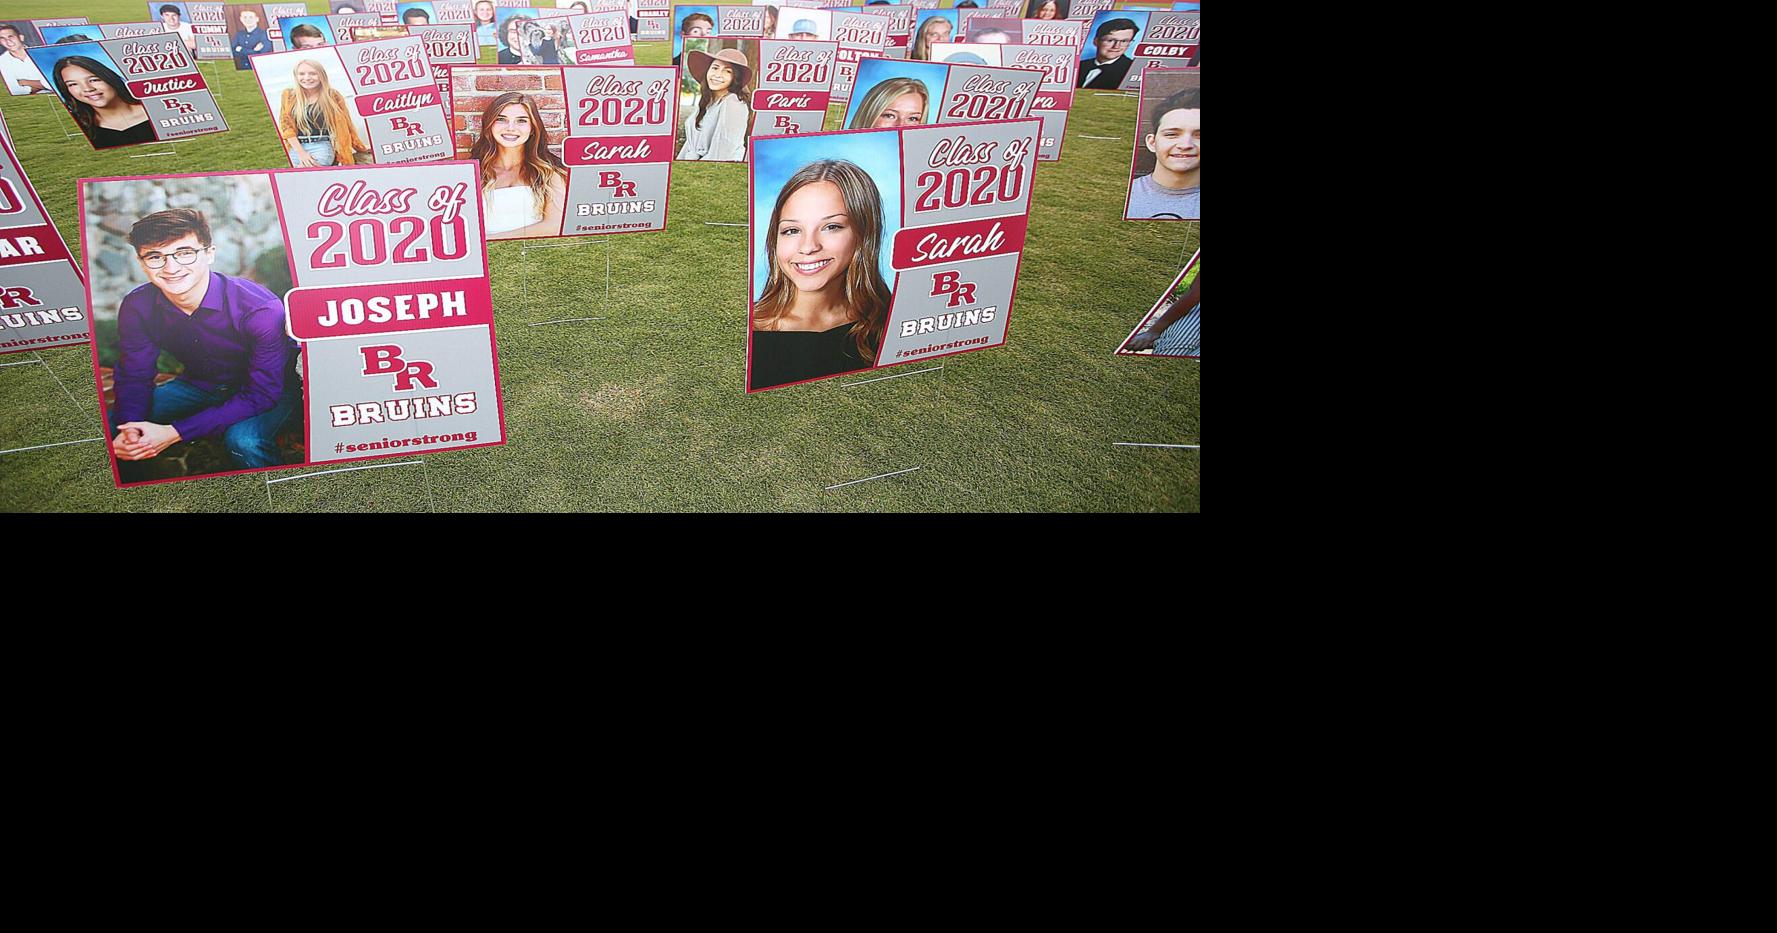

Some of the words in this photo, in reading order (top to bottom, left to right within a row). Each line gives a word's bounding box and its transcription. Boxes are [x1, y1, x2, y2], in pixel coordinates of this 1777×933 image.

[439, 9, 472, 20] 2020
[581, 16, 609, 28] Class
[726, 9, 749, 18] Class
[1158, 15, 1189, 25] Class
[195, 25, 227, 34] TOMMY
[722, 18, 761, 31] 2020
[841, 17, 870, 28] Class
[872, 21, 884, 32] of
[1032, 23, 1063, 34] Class
[1066, 25, 1080, 37] of
[1148, 25, 1200, 39] 2020
[422, 29, 452, 40] Class
[457, 31, 469, 43] of
[579, 26, 625, 44] 2020
[835, 27, 881, 45] 2020
[122, 42, 159, 55] Class
[165, 40, 178, 55] of
[358, 46, 399, 64] Class
[404, 44, 420, 63] of
[580, 49, 627, 62] Samantha
[774, 46, 813, 61] Class
[816, 50, 833, 66] of
[1143, 45, 1190, 56] COLBY
[122, 50, 188, 75] 2020
[1015, 50, 1052, 64] Class
[1056, 53, 1072, 70] of
[355, 58, 426, 87] 2020
[765, 62, 828, 83] 2020
[143, 78, 197, 94] Justice
[586, 75, 643, 96] Class
[647, 79, 670, 103] of
[962, 74, 1011, 93] Class
[1013, 82, 1035, 101] of
[161, 97, 197, 114] BR
[373, 91, 433, 113] Caitlyn
[767, 93, 812, 108] Paris
[947, 93, 1027, 119] 2020
[160, 112, 214, 128] BRUINS
[577, 97, 667, 127] 2020
[389, 116, 424, 136] BR
[381, 135, 443, 155] BRUINS
[581, 139, 652, 161] Sarah
[928, 135, 998, 168] Class
[1003, 137, 1032, 171] of
[598, 170, 638, 199] BR
[913, 162, 1026, 214] 2020
[317, 179, 417, 217] Class
[428, 182, 467, 224] of
[576, 200, 656, 217] BRUINS
[576, 221, 652, 232] #seniorstrong
[306, 215, 471, 271] 2020
[911, 222, 1006, 263] Sarah
[929, 270, 978, 308] BR
[318, 290, 467, 328] JOSEPH
[899, 306, 997, 338] BRUINS
[896, 335, 989, 358] #seniorstrong
[358, 343, 439, 392] BR
[329, 391, 478, 428] BRUINS
[334, 429, 477, 454] #seniorstrong
